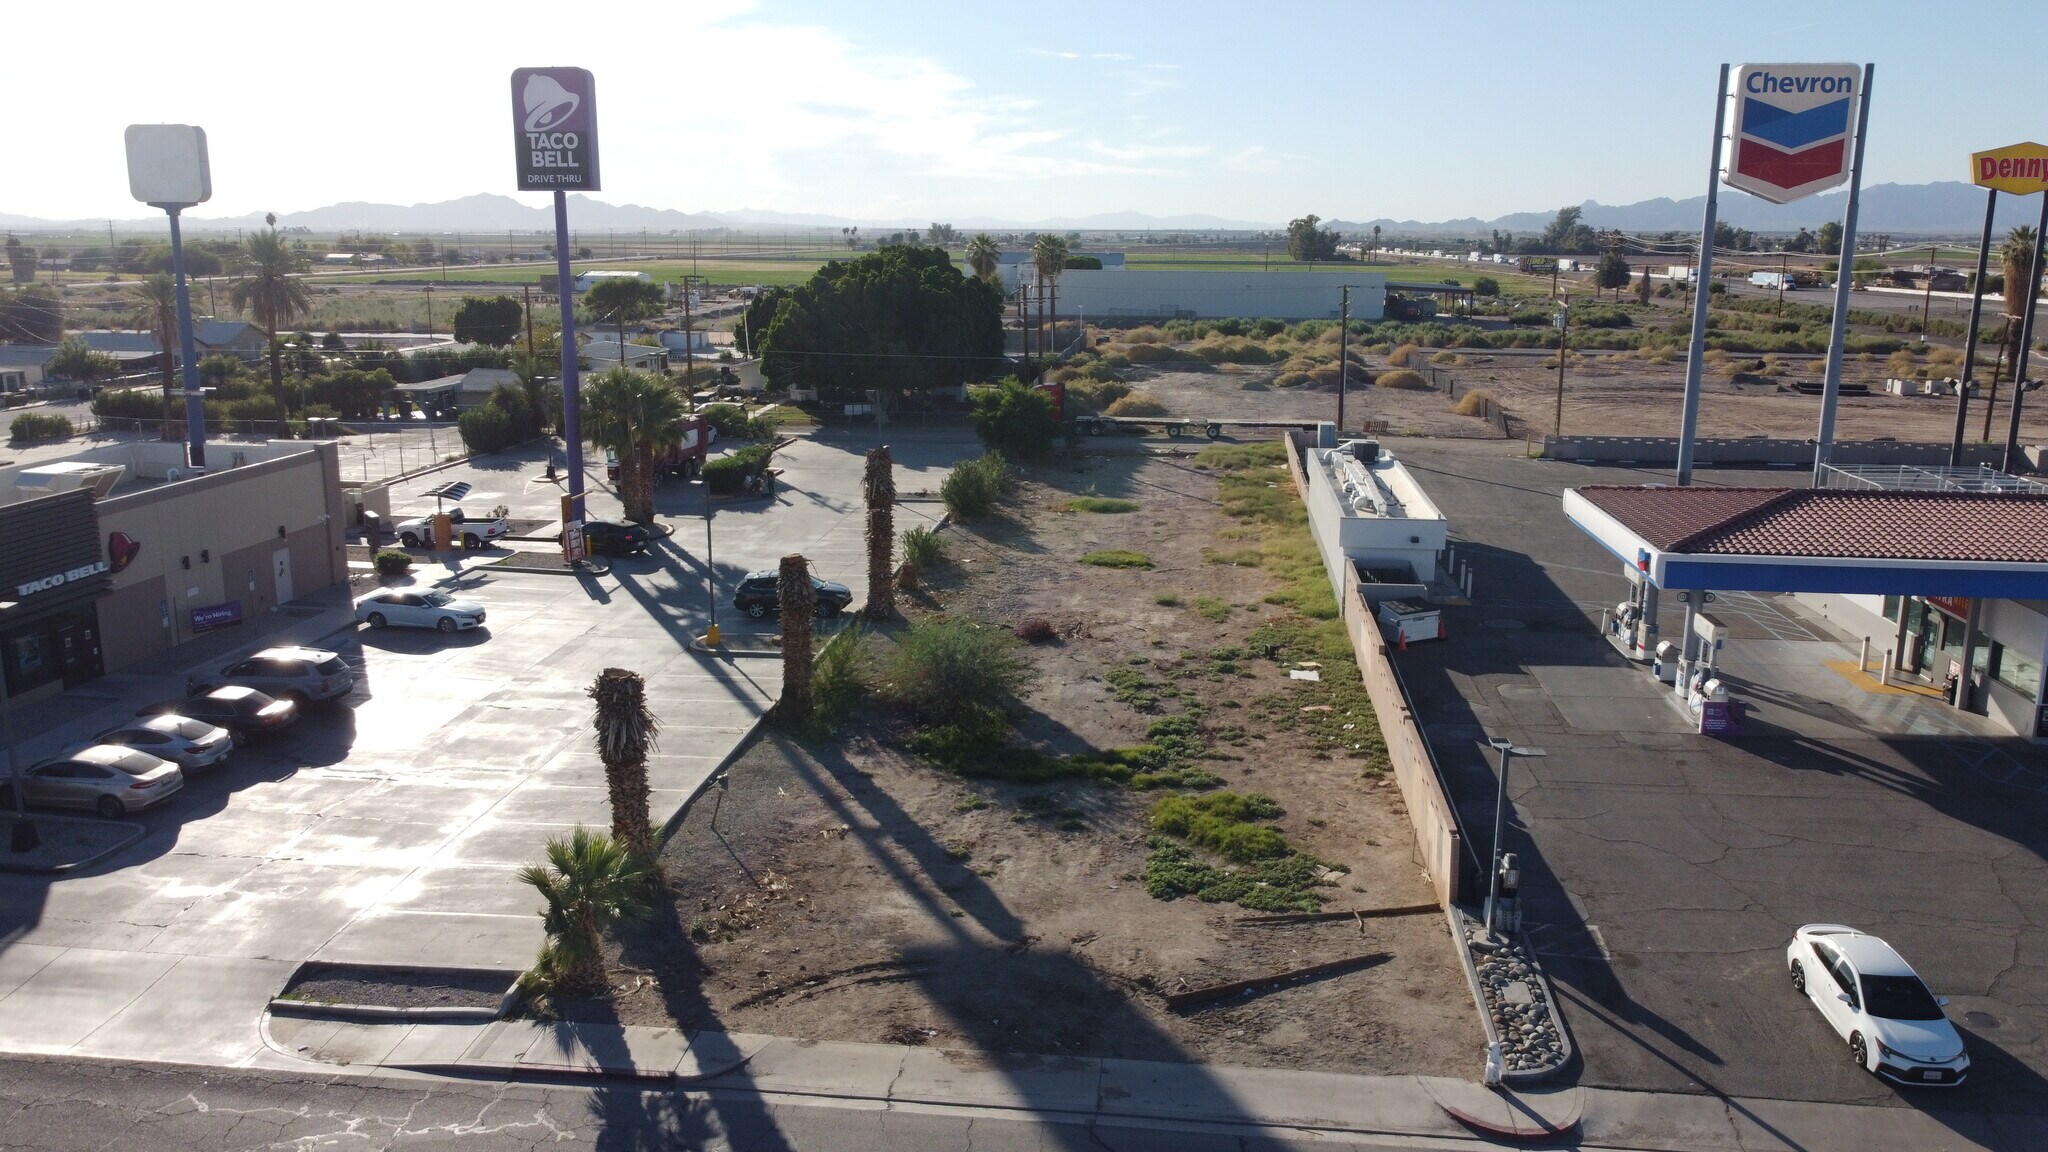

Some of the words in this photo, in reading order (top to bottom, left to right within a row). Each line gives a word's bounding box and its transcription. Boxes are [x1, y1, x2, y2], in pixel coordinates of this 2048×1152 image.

[1745, 71, 1852, 94] Chevron
[526, 132, 579, 150] TACO
[531, 150, 579, 168] BELL
[527, 174, 555, 183] DRIVE
[556, 174, 582, 183] THRU
[16, 574, 65, 596] TACO
[65, 561, 109, 582] BELL
[193, 614, 212, 622] We're
[212, 610, 233, 618] Hiring
